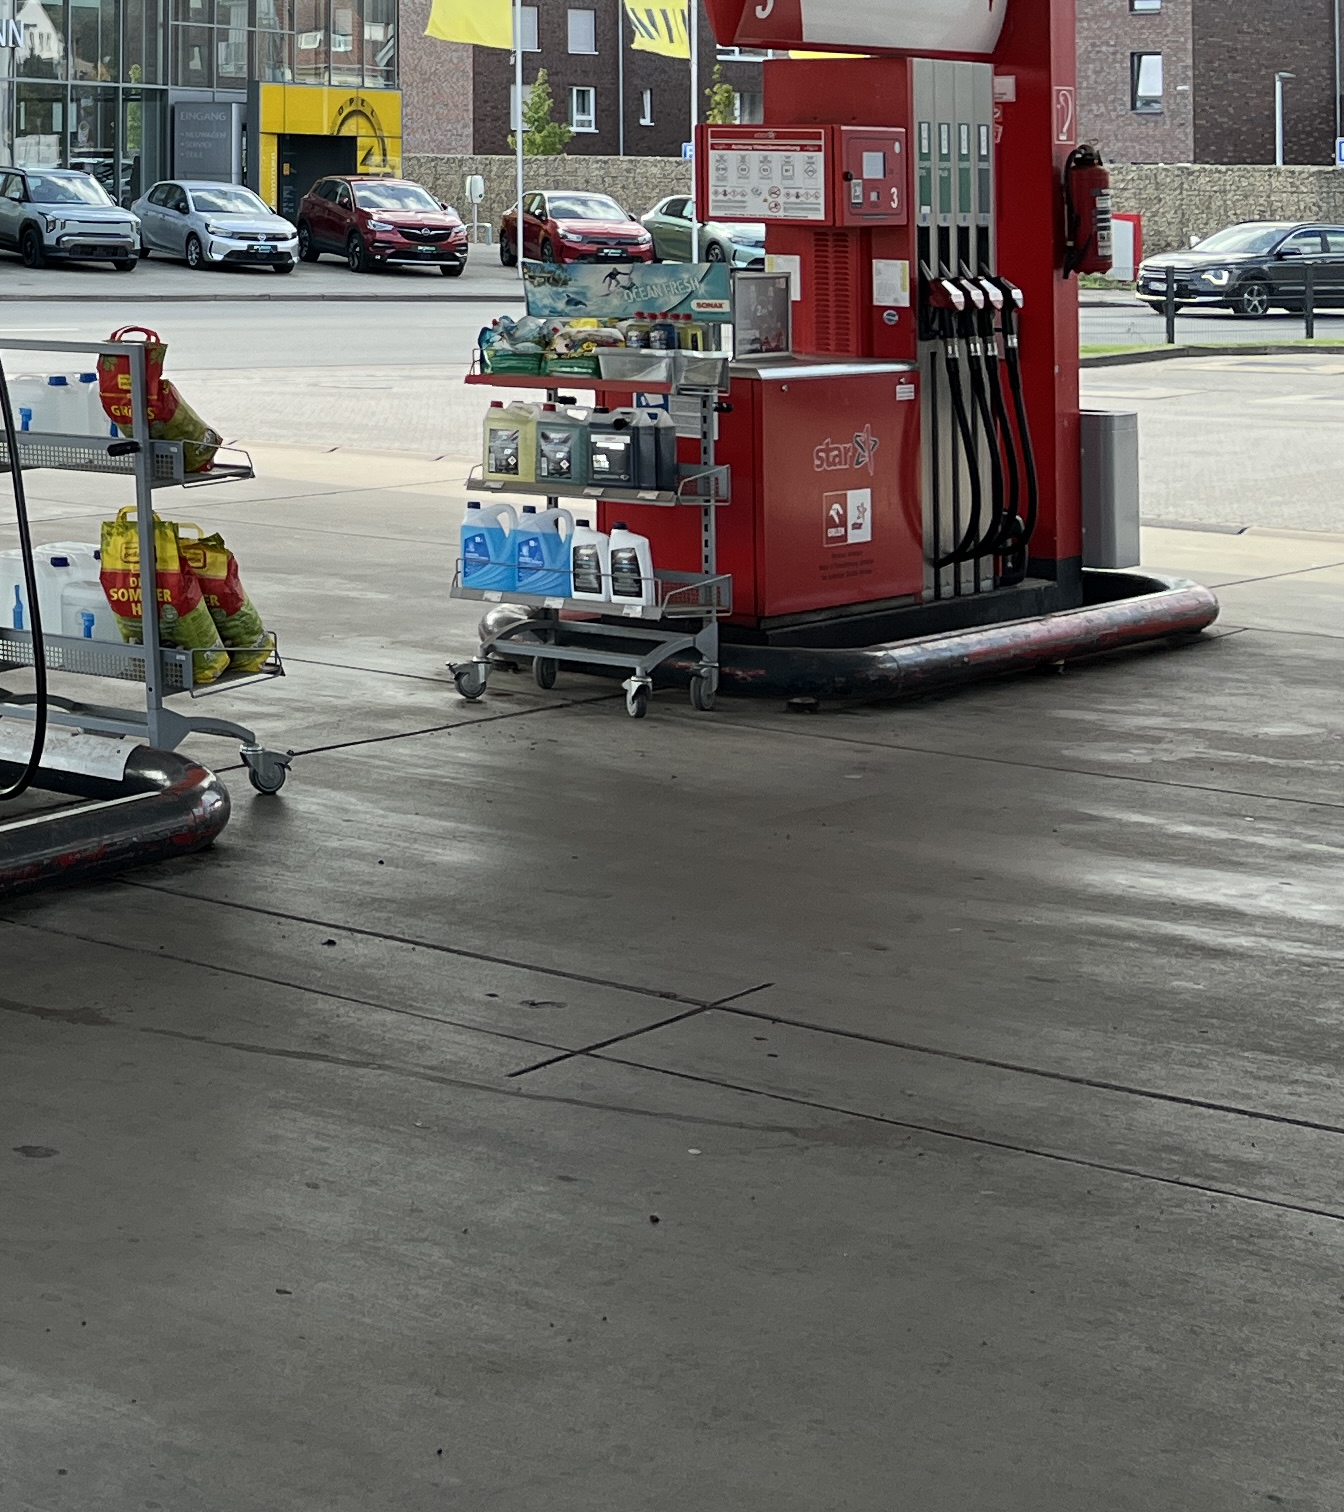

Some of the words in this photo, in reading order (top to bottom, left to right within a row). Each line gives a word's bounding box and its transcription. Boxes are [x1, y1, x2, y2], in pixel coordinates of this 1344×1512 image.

[180, 111, 227, 121] EINGANG
[890, 186, 899, 209] 3
[696, 301, 724, 309] SONAX
[813, 437, 853, 472] star
[109, 588, 172, 603] SOMER
